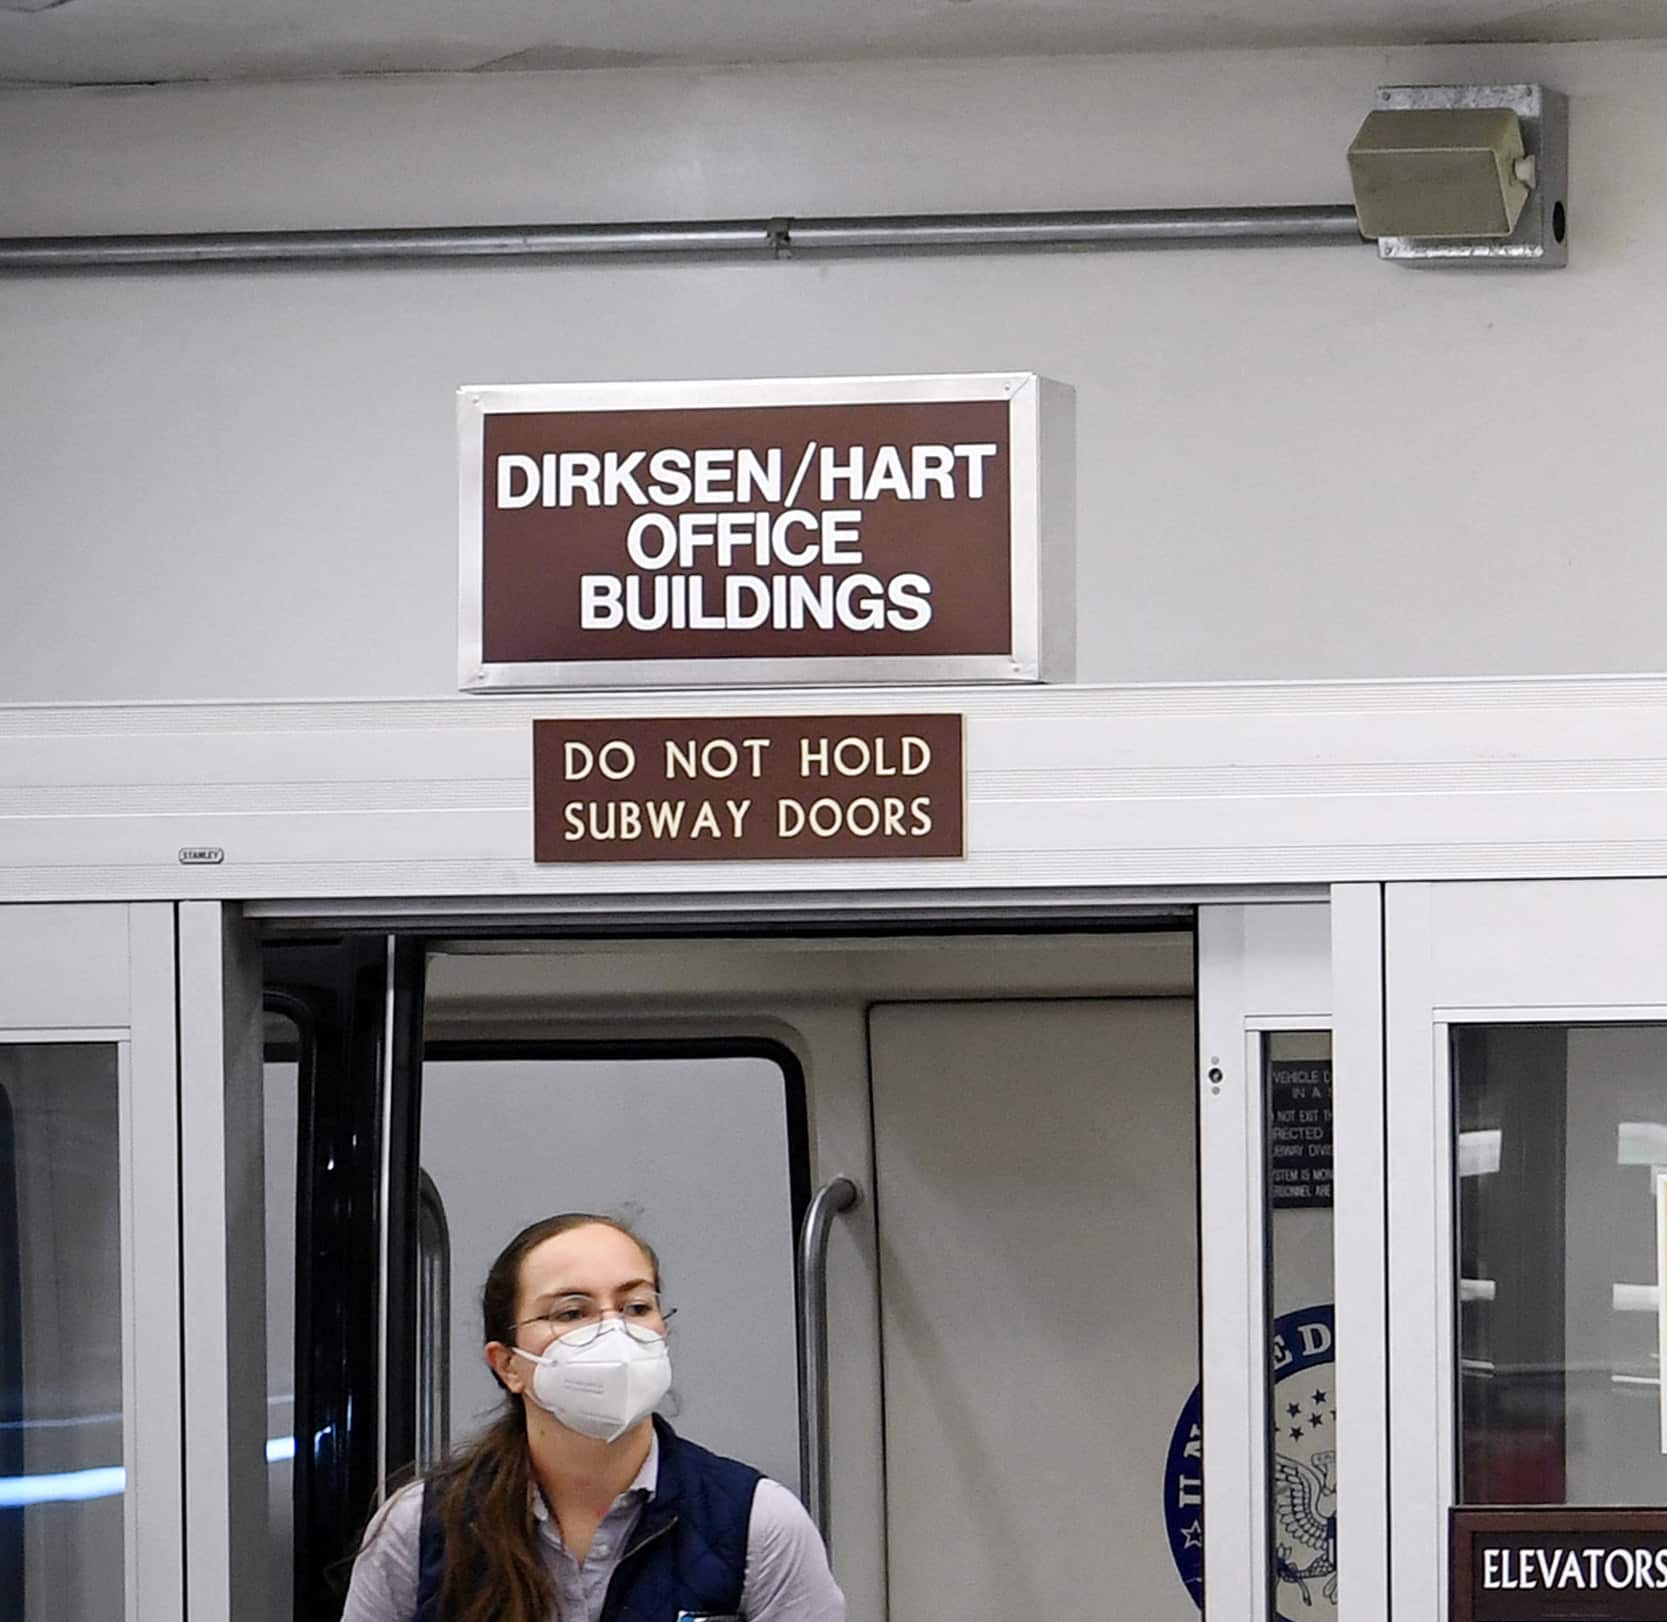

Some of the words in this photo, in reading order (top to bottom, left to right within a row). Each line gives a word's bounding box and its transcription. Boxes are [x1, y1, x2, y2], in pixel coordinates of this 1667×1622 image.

[497, 441, 997, 509] DIRKSEN/HART
[627, 509, 863, 570] OFFICE
[581, 573, 932, 631] BUILDINGS
[564, 741, 635, 780] DO
[665, 739, 770, 779] NOT
[800, 736, 931, 777] HOLD
[565, 799, 751, 841] SUBWAY
[778, 797, 932, 837] DOORS
[1272, 1071, 1319, 1083] VEHICLE
[1312, 1087, 1321, 1098] A
[1272, 1127, 1323, 1140] RECTED
